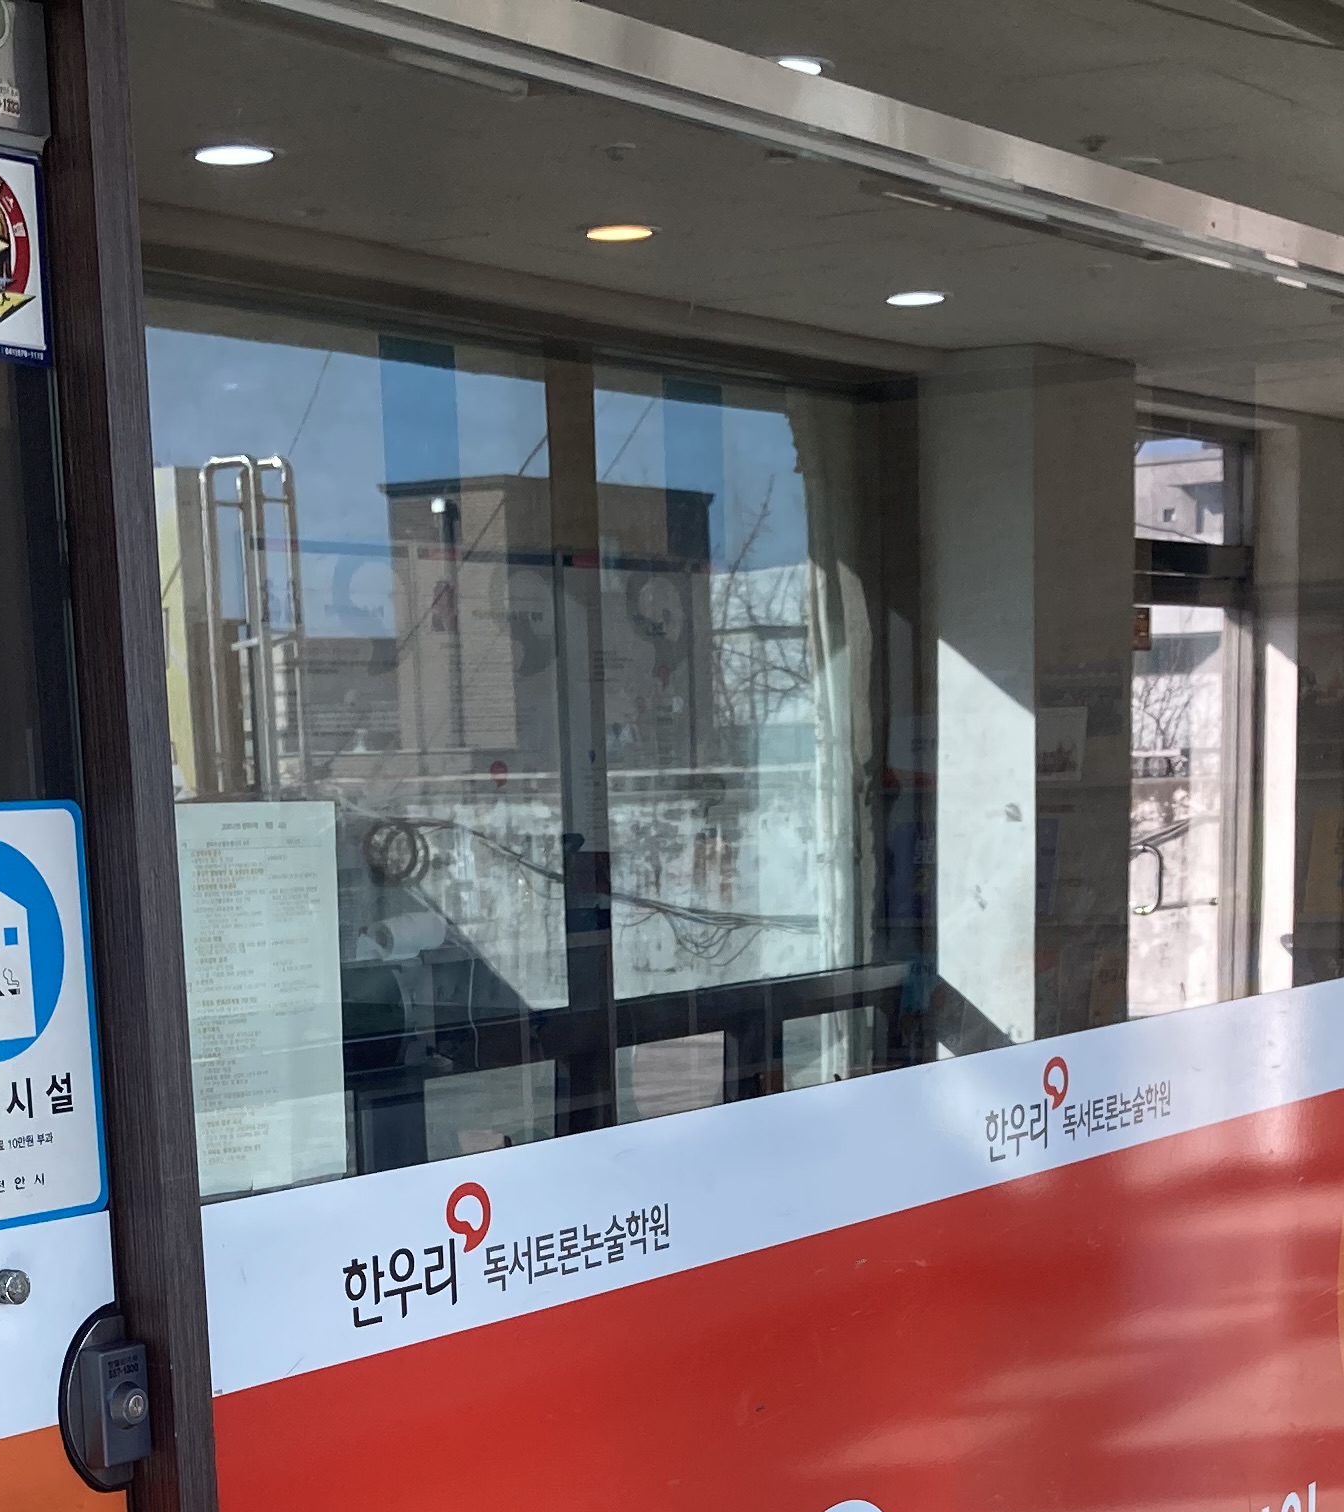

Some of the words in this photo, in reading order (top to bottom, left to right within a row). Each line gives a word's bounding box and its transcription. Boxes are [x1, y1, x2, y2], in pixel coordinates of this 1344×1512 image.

[8, 1134, 34, 1150] 10만원
[36, 1131, 54, 1146] 부과
[985, 1098, 1049, 1163] 한우리
[1062, 1079, 1172, 1142] 독서토론논술학원
[342, 1237, 458, 1329] 한우리
[484, 1202, 670, 1292] 독서토론논술학원
